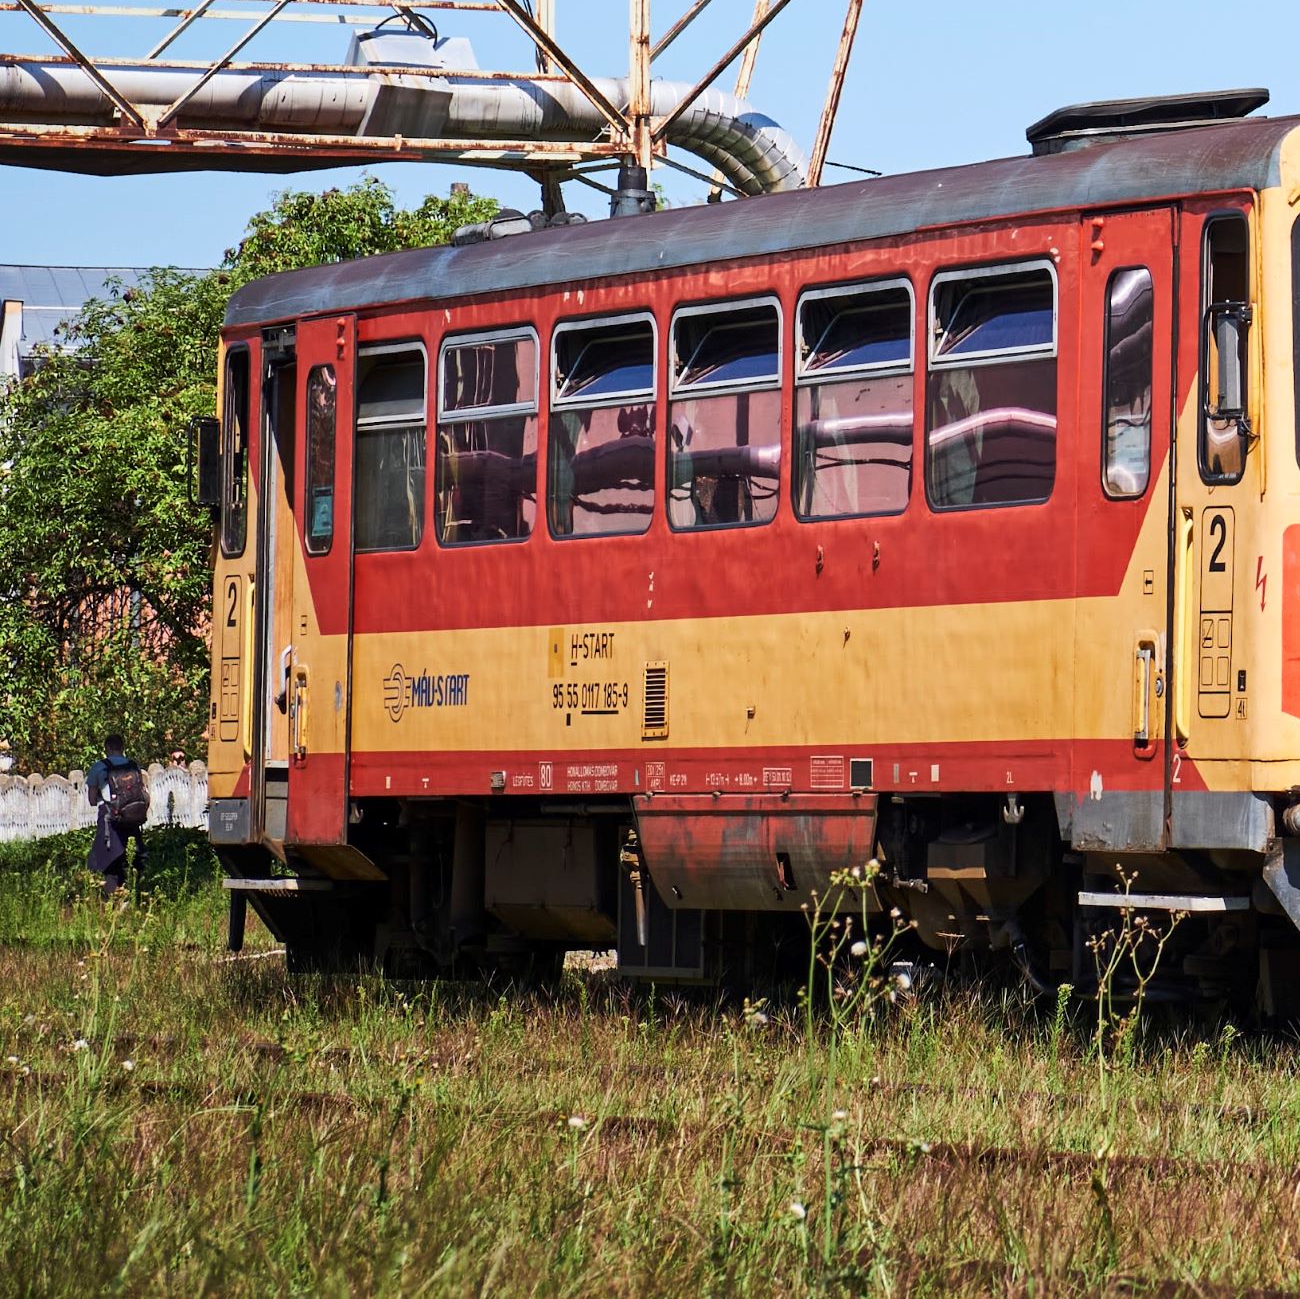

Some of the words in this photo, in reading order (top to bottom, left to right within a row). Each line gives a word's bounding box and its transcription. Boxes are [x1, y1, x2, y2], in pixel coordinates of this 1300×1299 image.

[1208, 514, 1227, 572] 2
[227, 582, 237, 627] 2
[571, 633, 615, 663] H-START
[553, 683, 564, 709] 95
[567, 683, 579, 709] 55
[581, 683, 600, 709] 0117
[603, 682, 628, 708] 185-9
[540, 764, 551, 788] 80
[1172, 753, 1181, 783] 2
